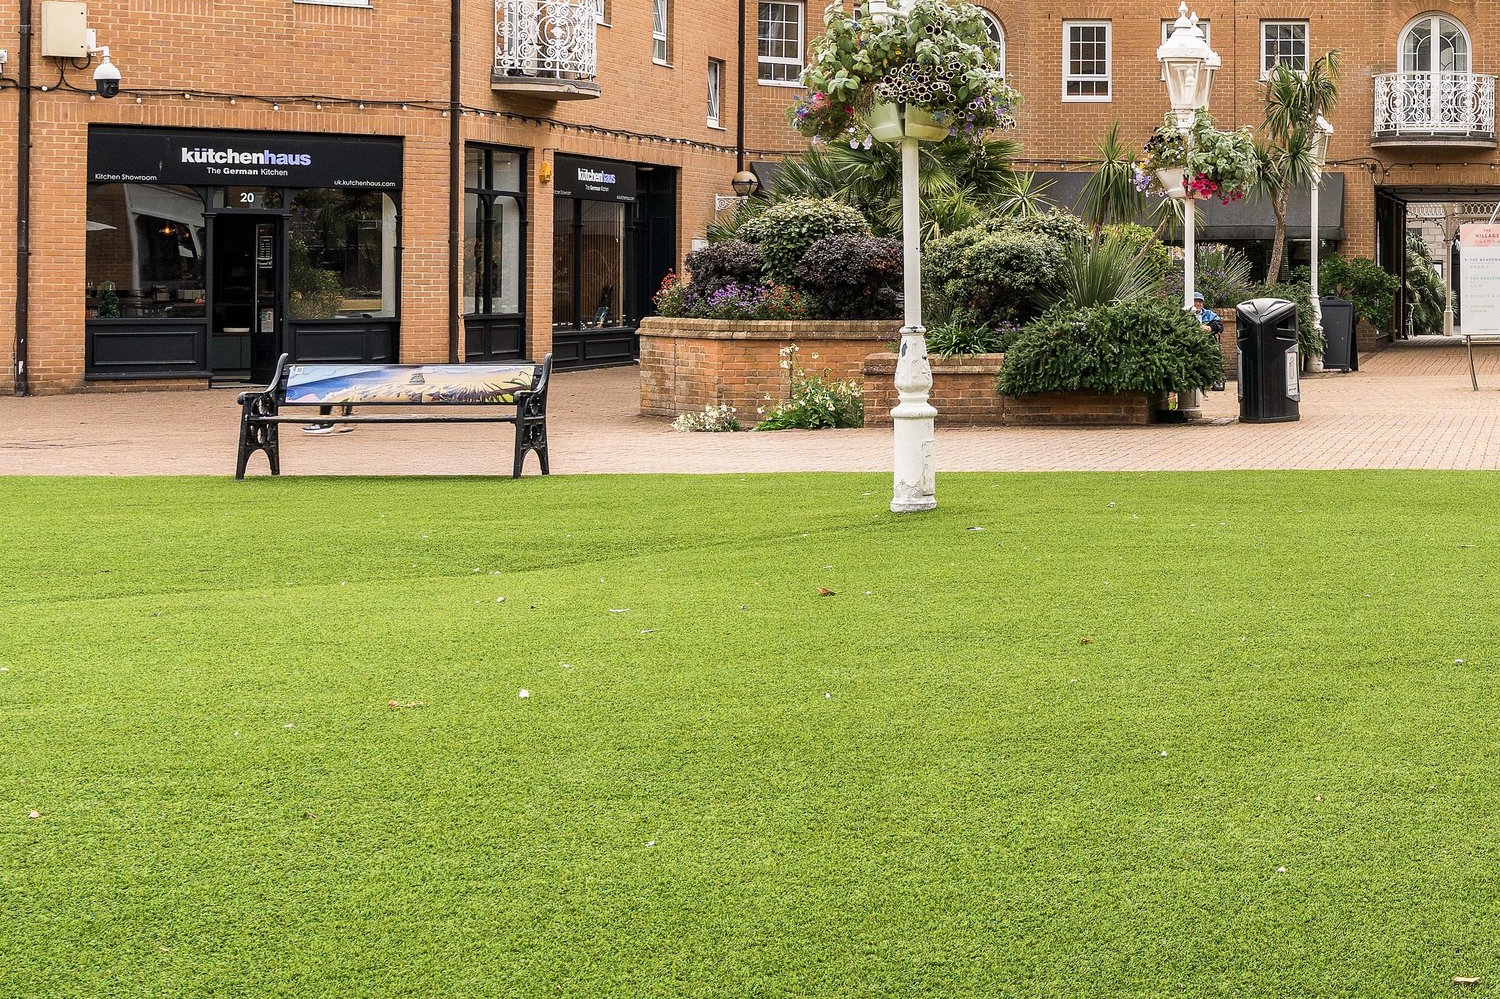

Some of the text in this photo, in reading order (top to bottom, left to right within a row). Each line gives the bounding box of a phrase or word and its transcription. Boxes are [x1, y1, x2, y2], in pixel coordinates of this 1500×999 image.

[181, 147, 312, 166] kütchenhaus
[207, 167, 288, 176] The German Kitchen
[240, 192, 254, 203] 20
